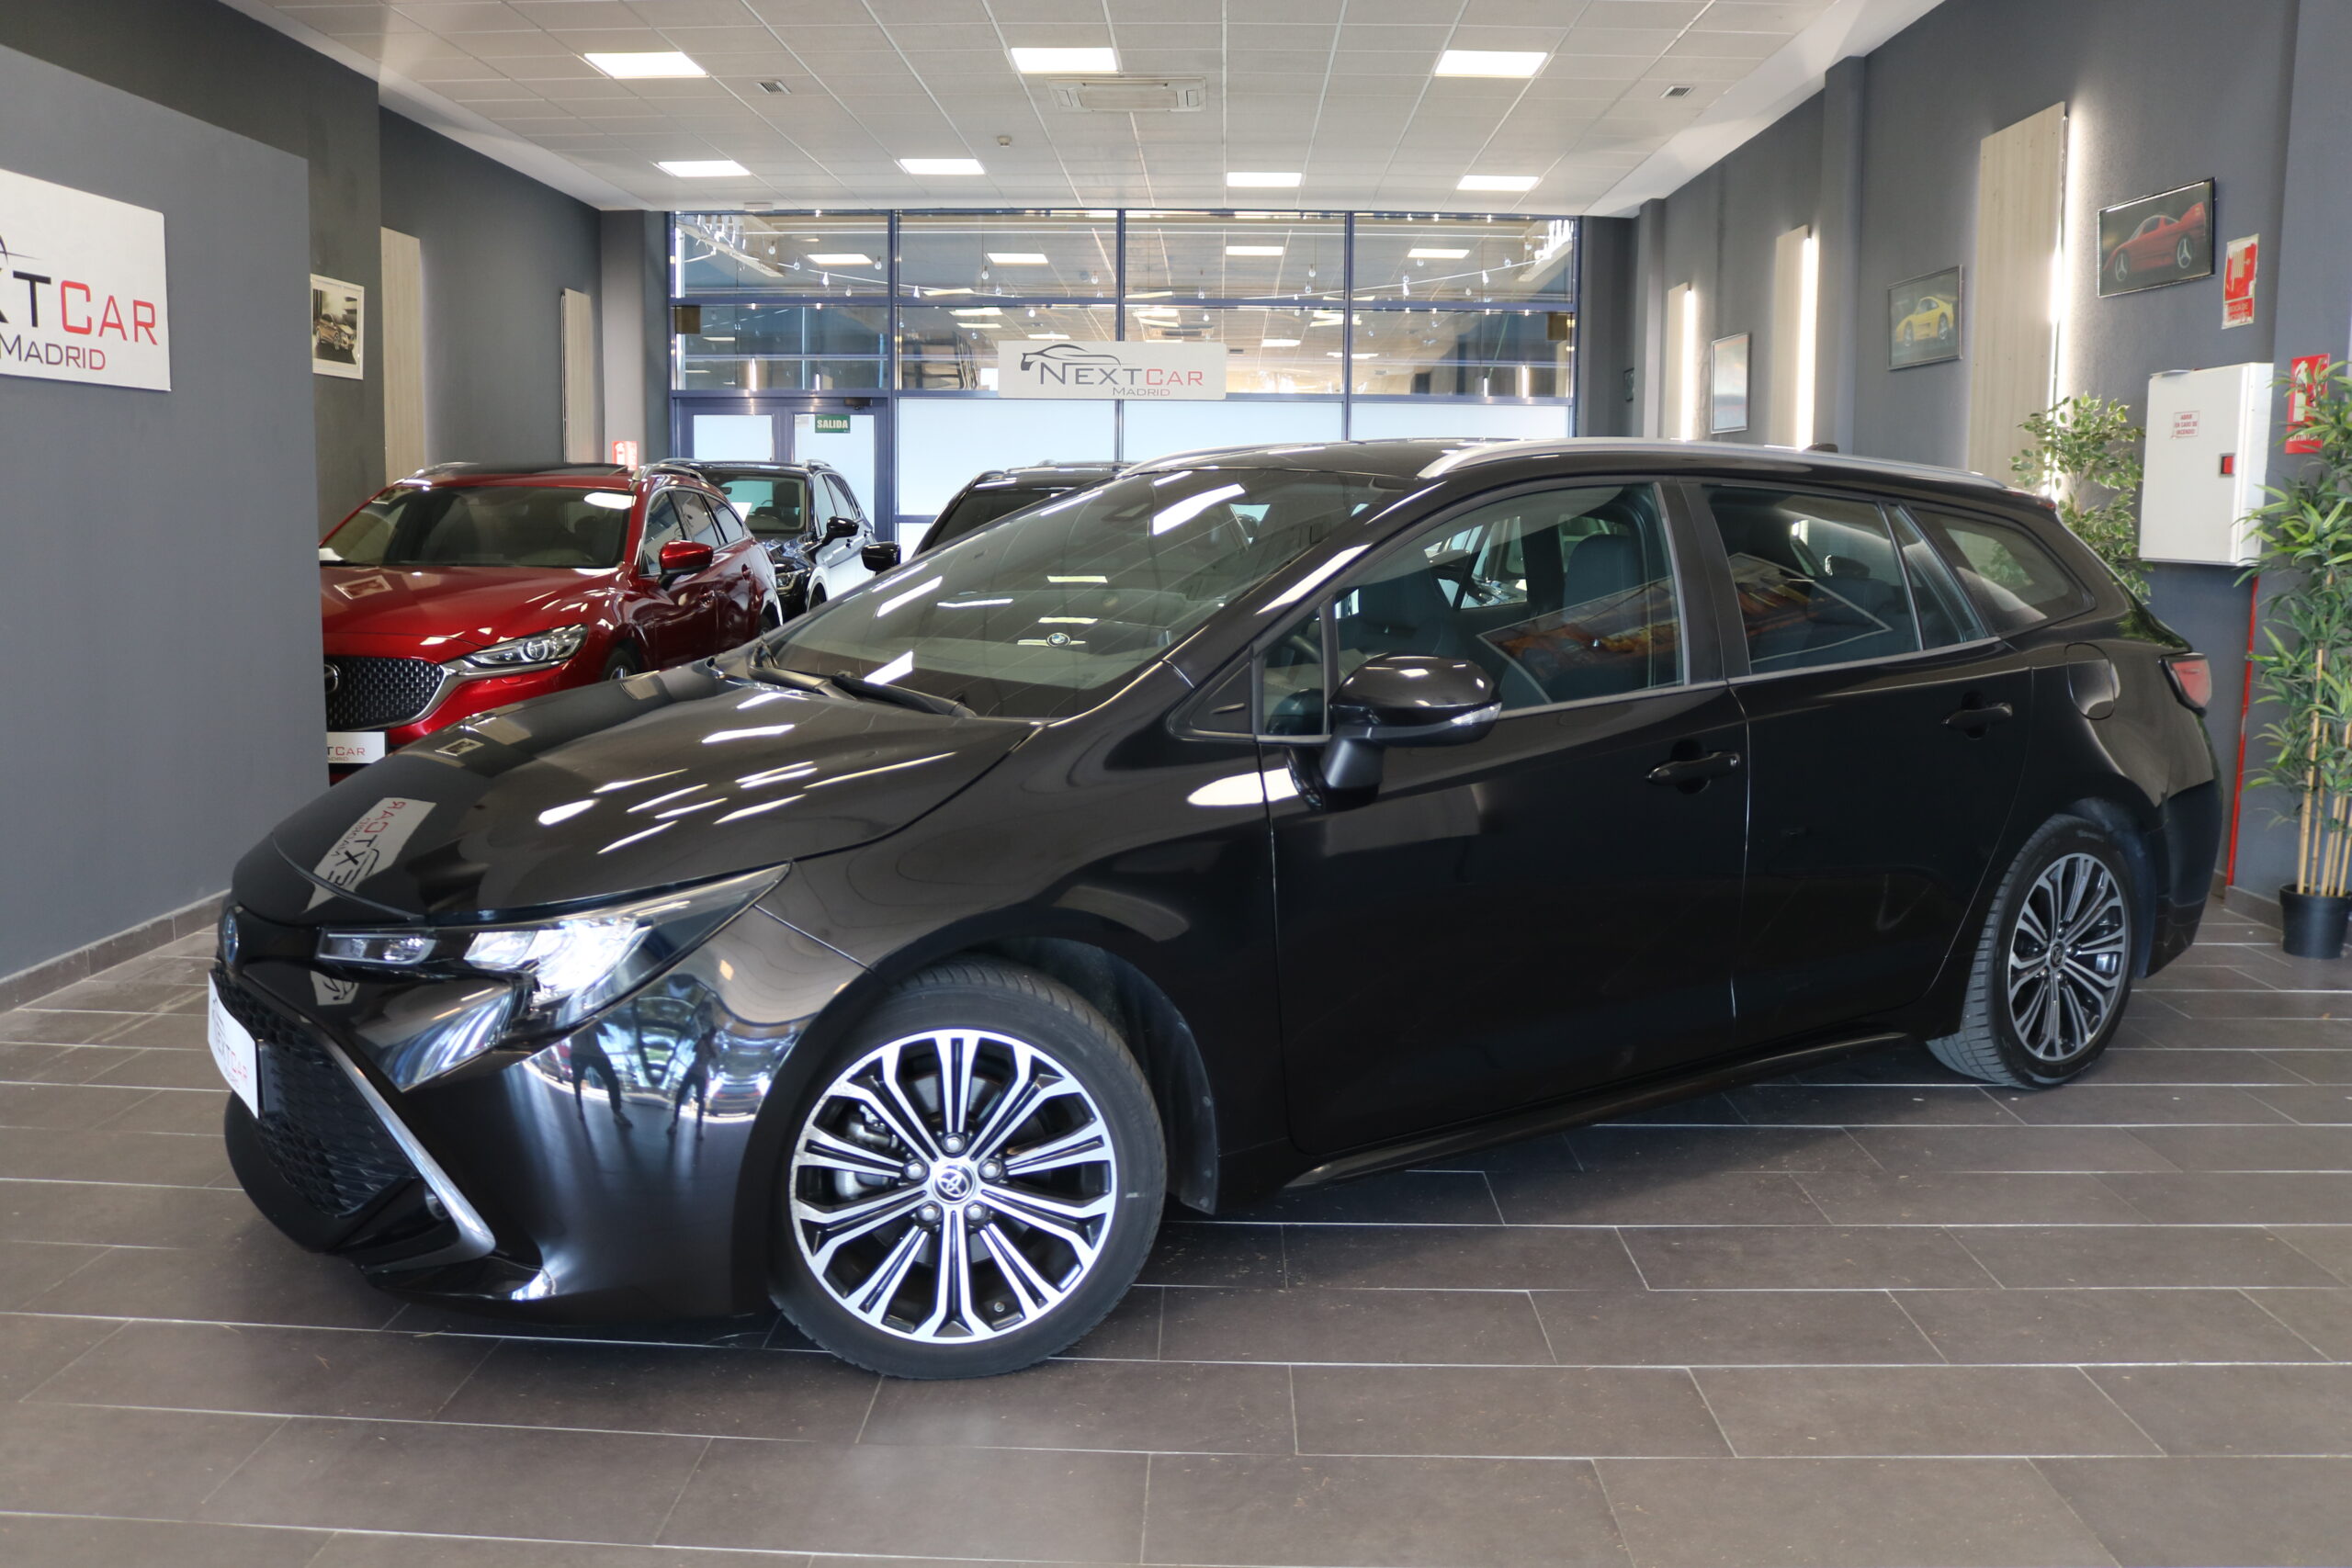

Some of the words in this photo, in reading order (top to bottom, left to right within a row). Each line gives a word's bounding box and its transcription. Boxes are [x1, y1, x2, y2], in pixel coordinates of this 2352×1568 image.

[0, 267, 158, 346] TCAR
[0, 333, 106, 370] MADRID
[1113, 387, 1170, 397] MADRID
[817, 419, 848, 429] SALIDA
